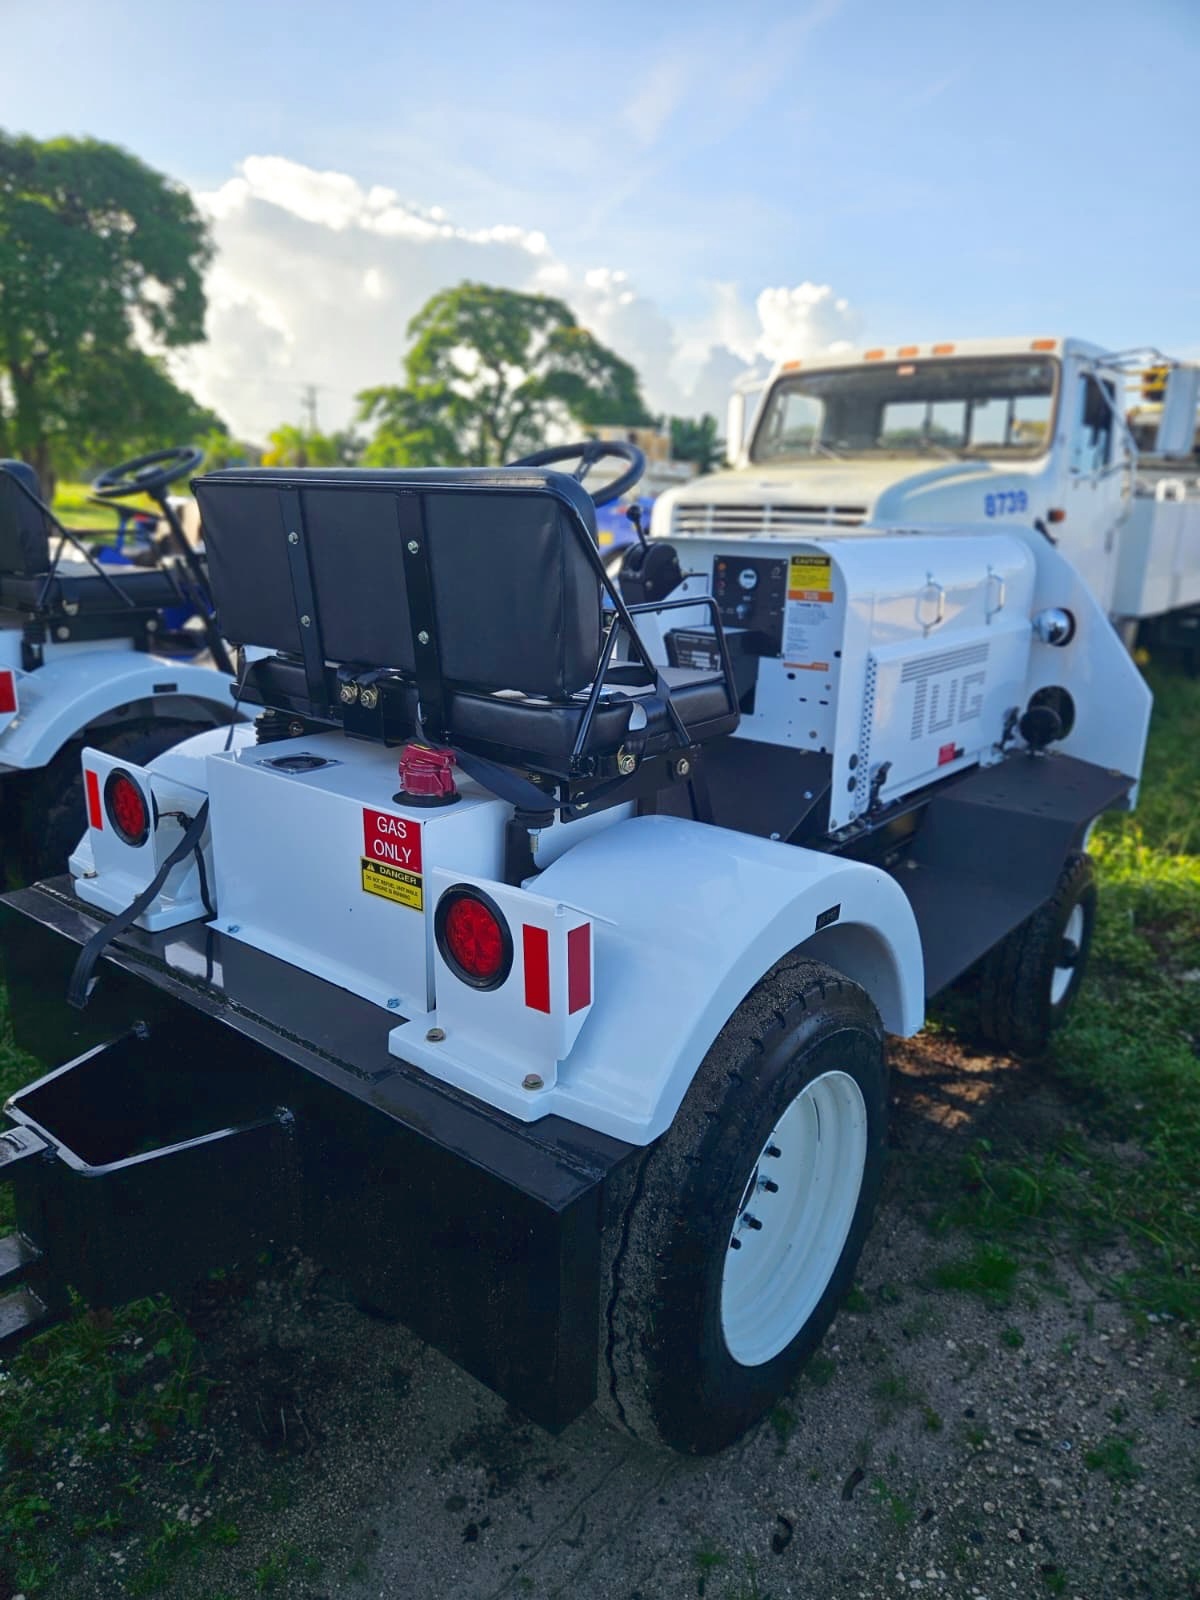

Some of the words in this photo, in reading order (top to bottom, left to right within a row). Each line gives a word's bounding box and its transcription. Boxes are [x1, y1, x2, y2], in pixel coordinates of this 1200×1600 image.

[901, 643, 990, 741] TUG
[377, 816, 408, 839] GAS
[373, 839, 412, 864] ONLY
[379, 866, 417, 885] DANGER
